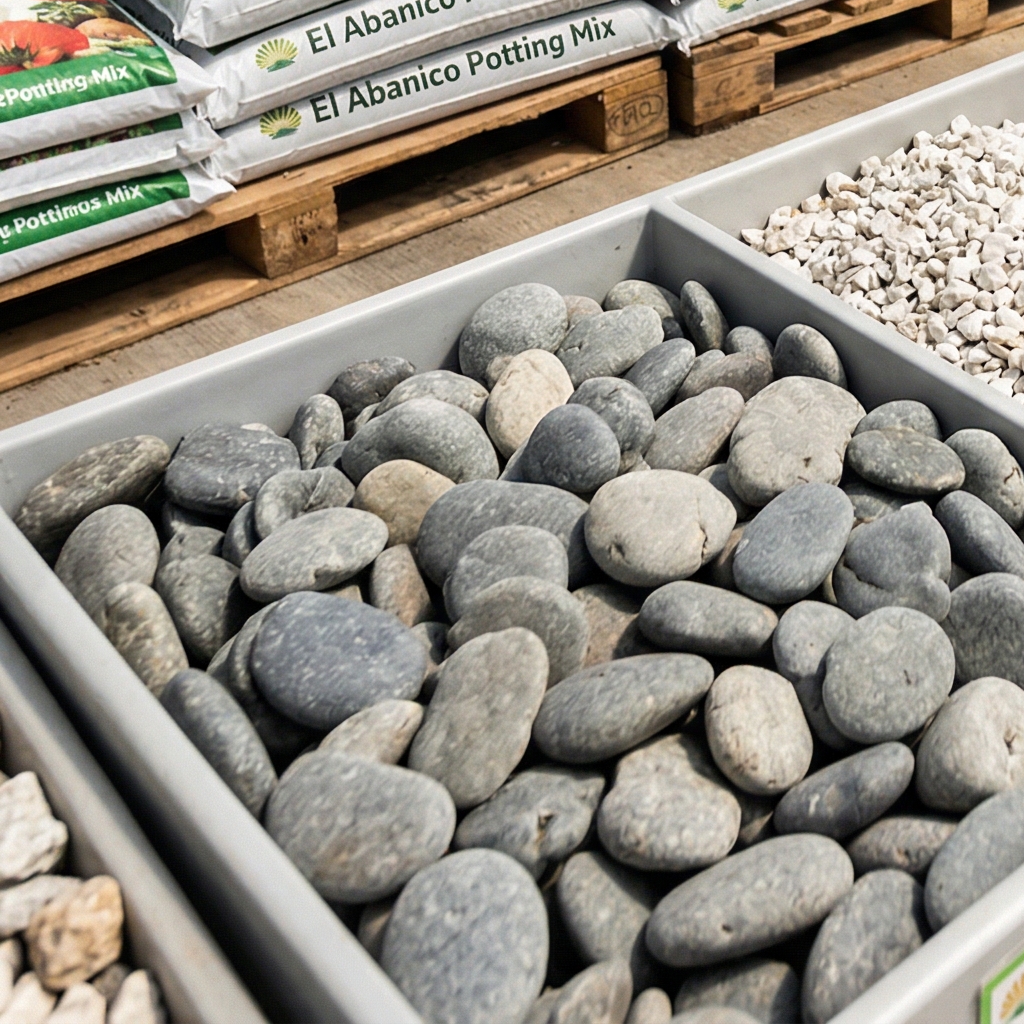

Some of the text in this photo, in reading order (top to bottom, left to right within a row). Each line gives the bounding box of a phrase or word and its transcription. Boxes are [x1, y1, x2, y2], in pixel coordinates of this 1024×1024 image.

[306, 23, 337, 55] El
[91, 64, 129, 85] Mix
[309, 16, 616, 123] El Abanico Potting Mix
[105, 184, 144, 206] Mix
